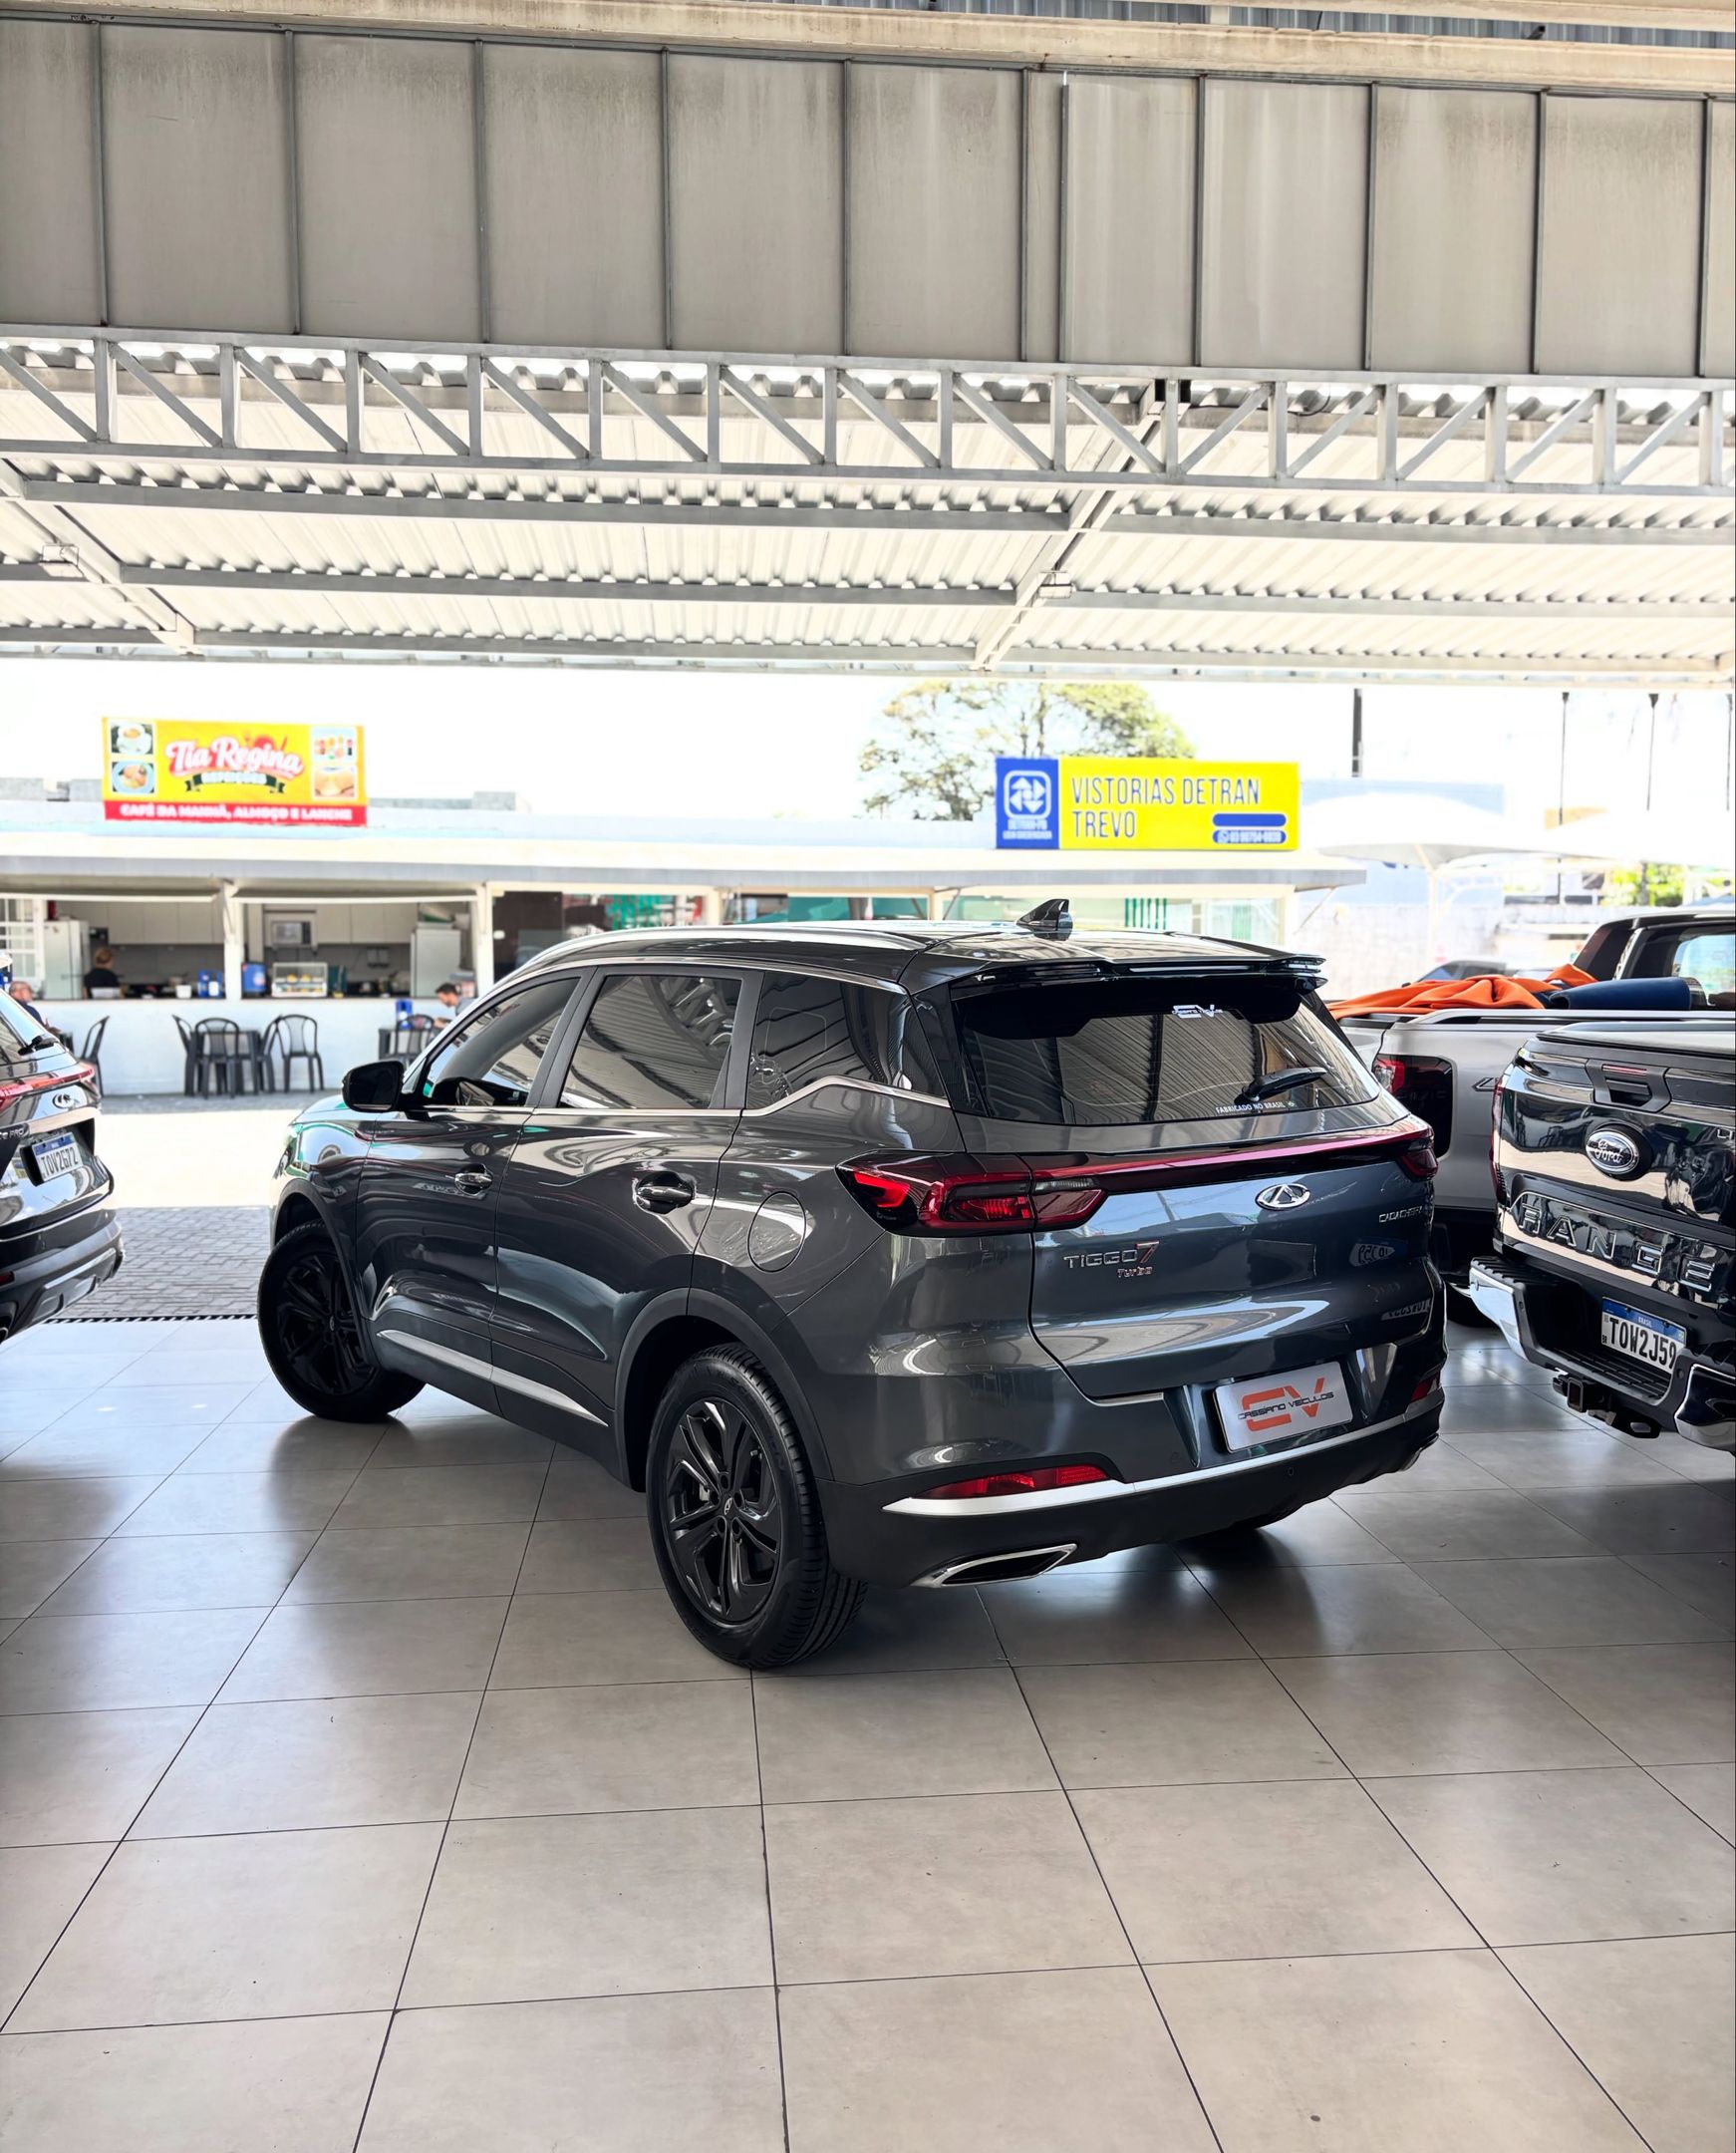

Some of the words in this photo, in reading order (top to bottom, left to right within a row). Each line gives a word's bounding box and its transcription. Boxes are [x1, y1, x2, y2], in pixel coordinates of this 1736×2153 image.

[165, 740, 211, 773] Tia
[210, 737, 303, 776] Regina
[1071, 777, 1175, 804] VISTORIAS
[1182, 777, 1261, 804] DETRAN
[156, 804, 177, 817] DA
[1071, 810, 1136, 838] TREVO
[1216, 1103, 1253, 1113] FABRICADO
[1594, 1139, 1624, 1164] Ford
[1520, 1201, 1715, 1293] RANGE
[1609, 1317, 1677, 1371] TOW2J59
